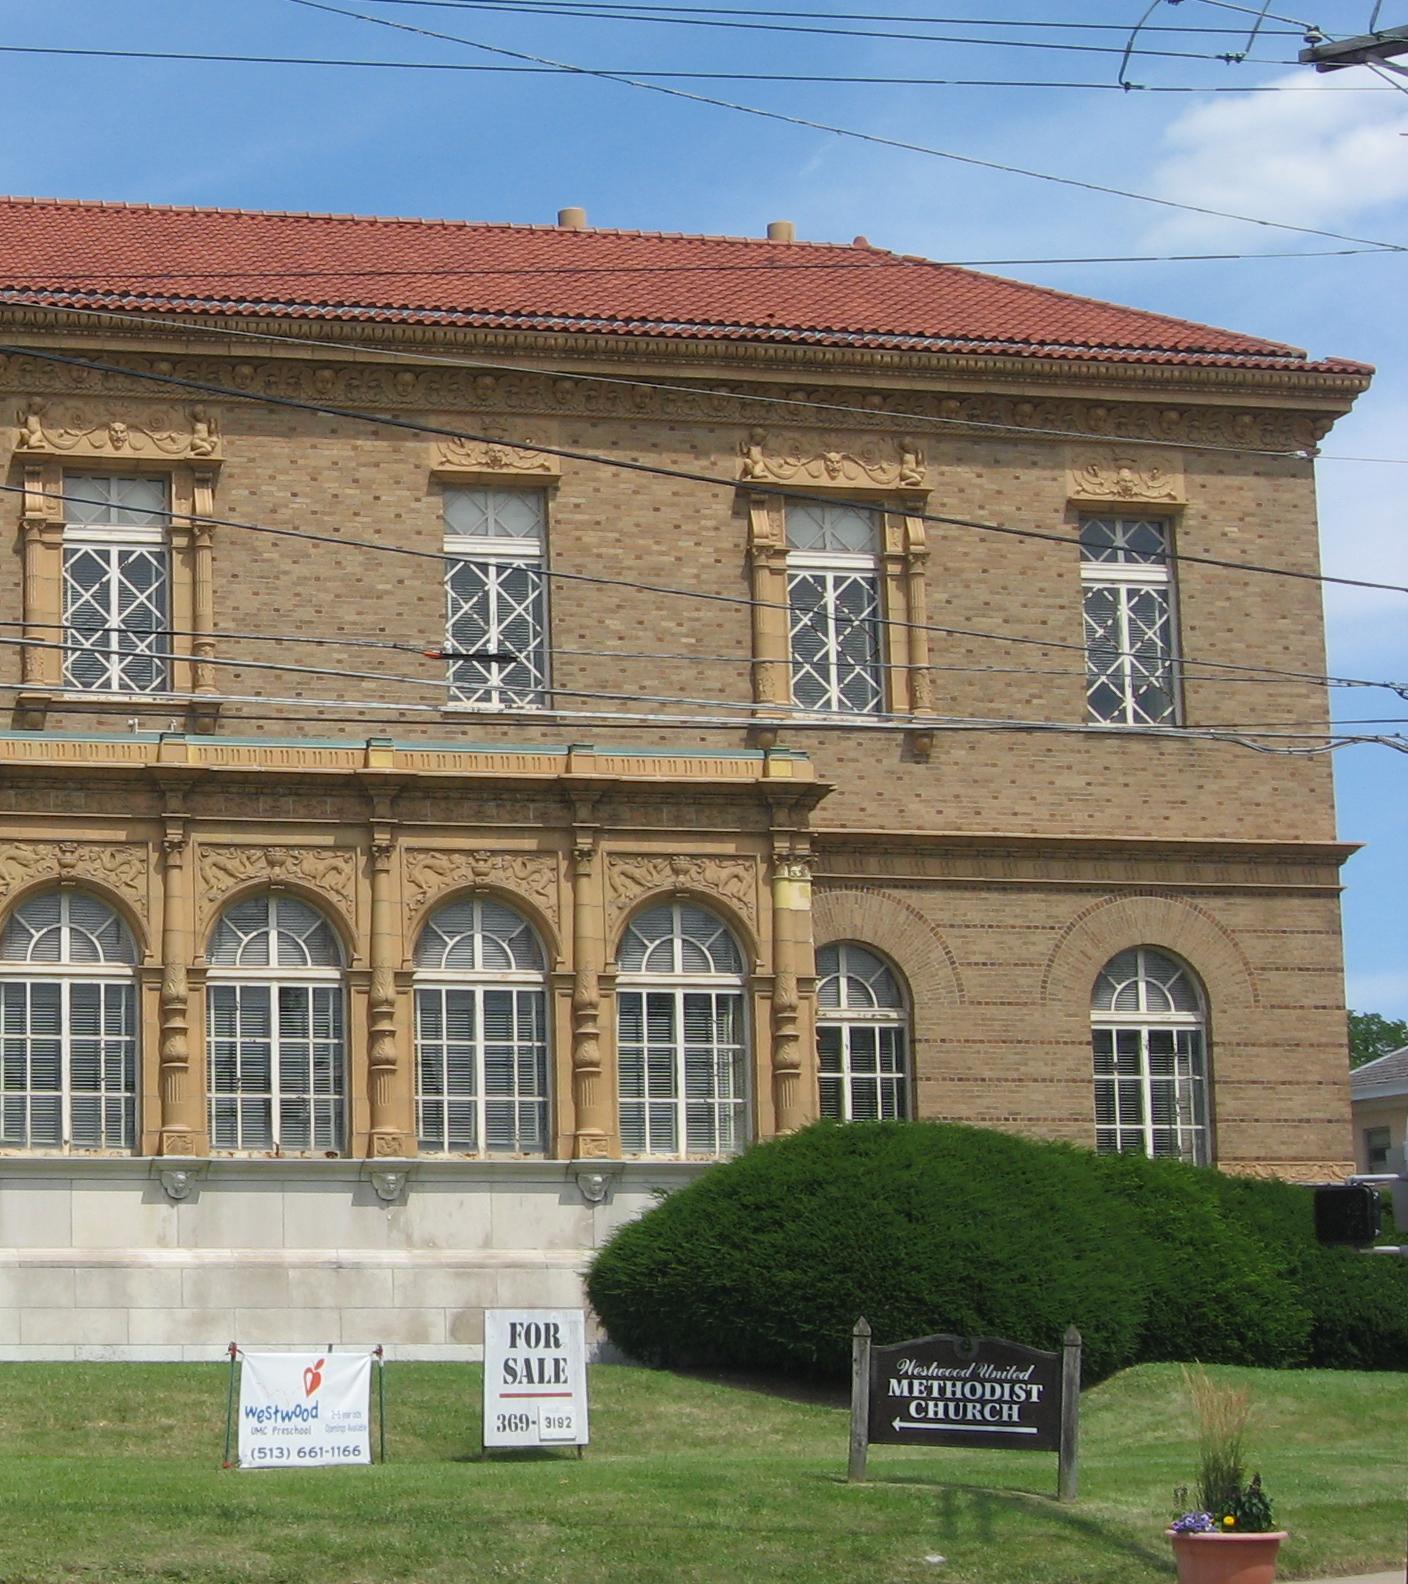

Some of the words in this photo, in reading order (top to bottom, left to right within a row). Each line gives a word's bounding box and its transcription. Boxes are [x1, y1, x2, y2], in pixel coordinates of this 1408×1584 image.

[508, 1321, 562, 1349] FOR
[502, 1357, 568, 1385] SALE
[897, 1358, 975, 1379] Westwood
[977, 1363, 1035, 1381] United
[887, 1378, 1043, 1402] METHODIST
[908, 1399, 1021, 1422] CHURCH
[251, 1425, 268, 1435] UMC
[272, 1425, 312, 1436] Preschool
[250, 1446, 291, 1460] (513)
[296, 1444, 362, 1458] 661-1166
